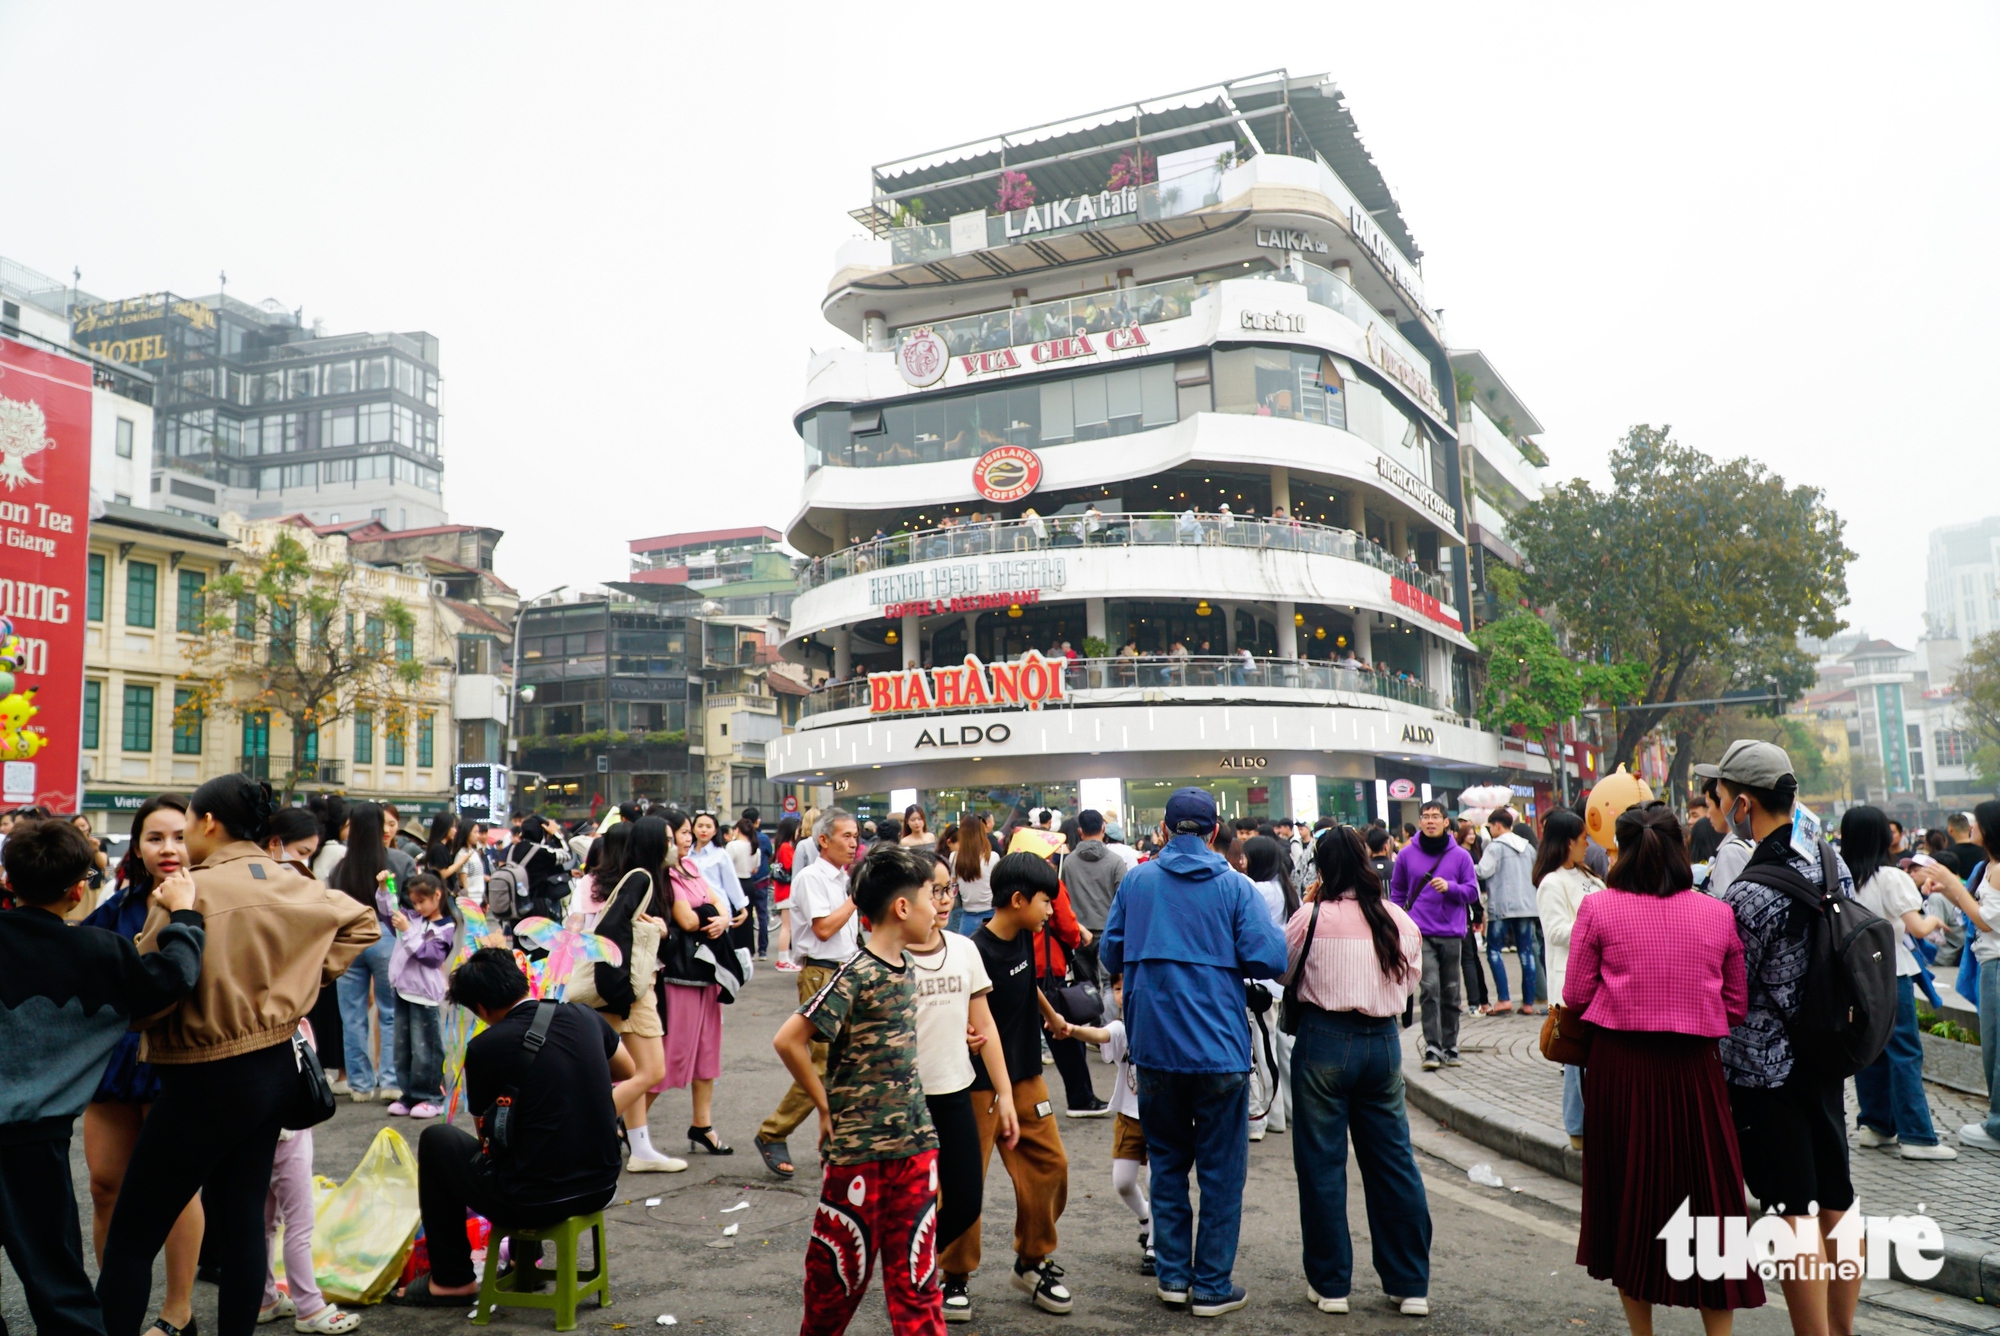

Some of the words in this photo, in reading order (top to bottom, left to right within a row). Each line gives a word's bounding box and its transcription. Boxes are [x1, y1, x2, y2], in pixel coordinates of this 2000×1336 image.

[1005, 194, 1097, 238] LAIKA
[1100, 186, 1138, 218] Café
[1256, 226, 1315, 252] LAIKA
[118, 310, 163, 325] LOUNGE
[88, 334, 168, 364] HOTEL
[961, 346, 1021, 376] VUA
[1031, 327, 1097, 364] CHẢ
[1105, 320, 1150, 350] CÁ
[976, 448, 1037, 476] HIGHLANDS
[984, 481, 1032, 500] COFFEE
[1378, 456, 1430, 505] HIGHLANDS
[1429, 493, 1456, 526] COFFEE
[34, 503, 73, 534] Tea
[7, 526, 56, 558] Giang
[868, 570, 925, 606] HANOI
[930, 562, 980, 597] 1930
[988, 557, 1067, 592] BISTRO
[884, 601, 932, 619] COFFEE
[935, 599, 946, 614] &
[950, 588, 1041, 613] RESTAURANT
[868, 670, 932, 714] BIA
[933, 656, 989, 708] HÀ
[991, 652, 1065, 711] NỘI
[914, 723, 1011, 749] ALDO
[1401, 723, 1434, 745] ALDO
[1219, 756, 1268, 769] ALDO
[464, 777, 485, 791] FS
[460, 794, 489, 808] SPA
